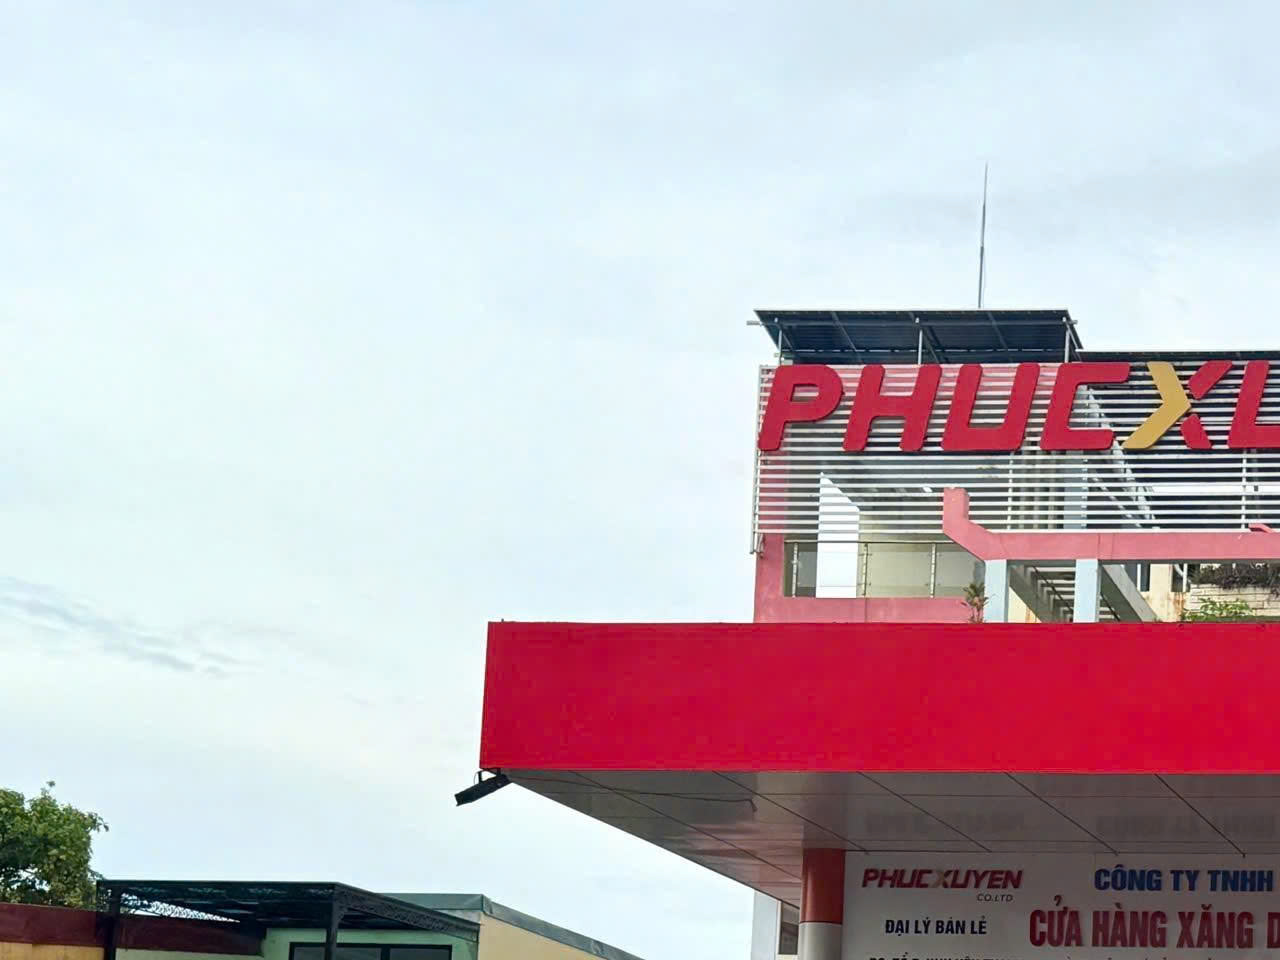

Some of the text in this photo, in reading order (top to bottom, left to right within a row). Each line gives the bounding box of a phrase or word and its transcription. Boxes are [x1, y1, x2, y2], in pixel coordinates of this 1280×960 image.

[1094, 864, 1162, 892] CÔNG
[1170, 869, 1200, 892] TY
[1208, 869, 1274, 892] TNHH
[885, 914, 987, 937] ĐẠI LÝ BÁN LẺ
[1029, 895, 1084, 947] CỬA
[1092, 902, 1167, 948] HÀNG
[1176, 904, 1254, 949] XĂNG
